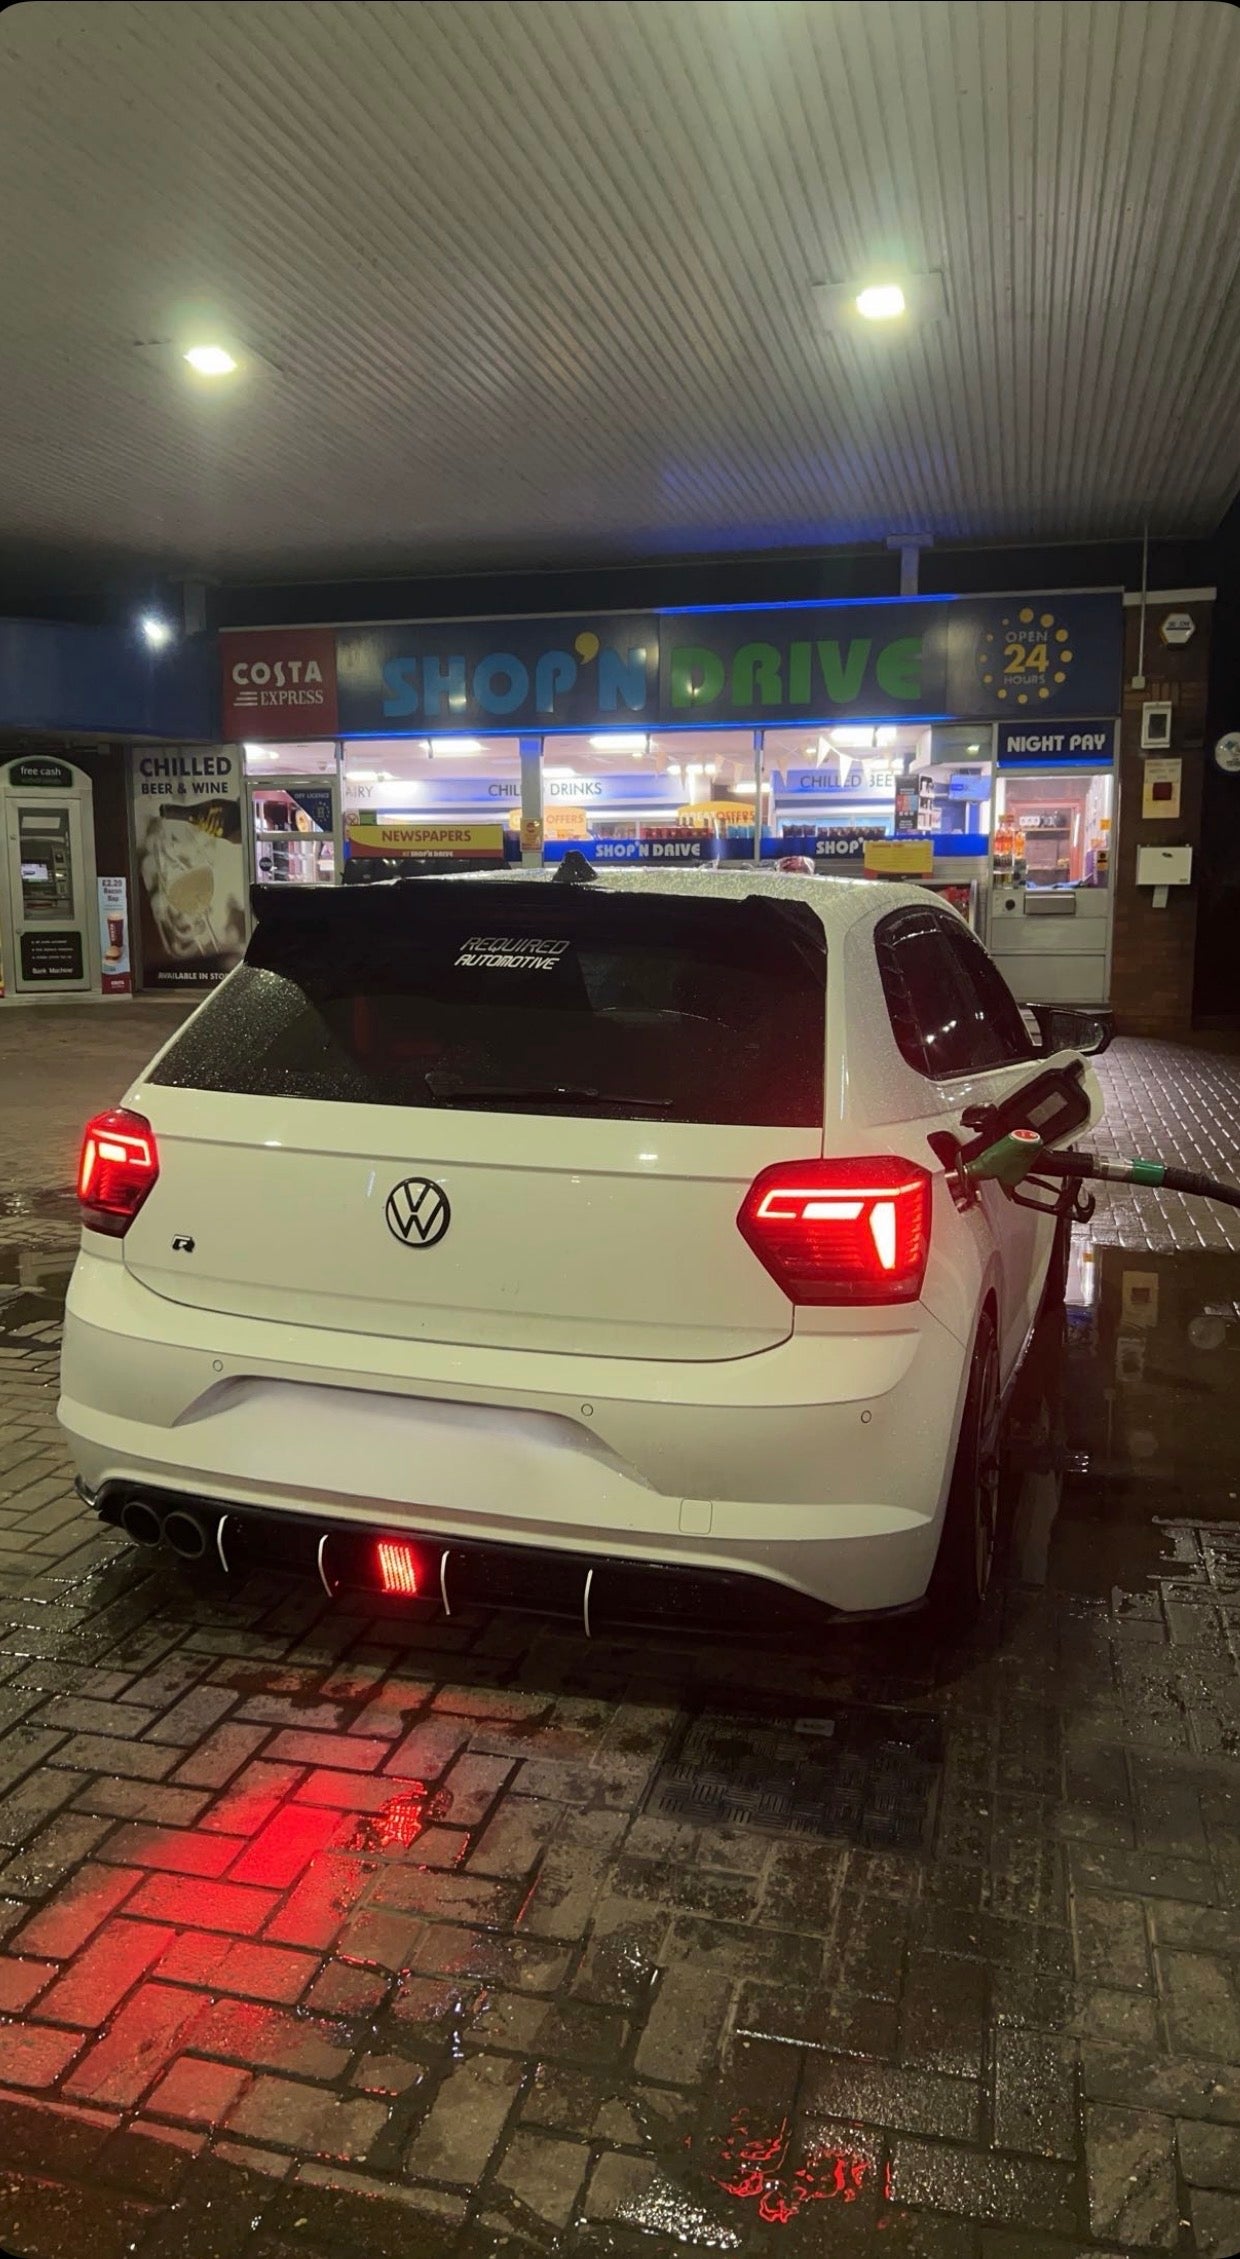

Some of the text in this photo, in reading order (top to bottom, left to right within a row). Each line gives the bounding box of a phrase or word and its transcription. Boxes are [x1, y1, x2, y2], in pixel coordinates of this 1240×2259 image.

[1005, 631, 1048, 643] OPEN
[1003, 643, 1049, 674] 24
[232, 661, 322, 687] COSTA
[383, 631, 922, 717] SHOP'N DRIVE
[1004, 675, 1046, 685] HOURS
[261, 690, 324, 706] EXPRESS
[1007, 734, 1106, 753] NIGHT PAY
[20, 766, 62, 776] free cash
[140, 757, 232, 777] CHILLED
[141, 782, 229, 795] BEER & WINE
[551, 783, 602, 796] DRINKS
[546, 814, 584, 825] OFFERS
[382, 830, 472, 842] NEWSPAPERS
[596, 841, 700, 857] SHOP'N DRIVE
[460, 937, 570, 954] REQUIRED
[454, 954, 560, 969] AUTOMOTIVE
